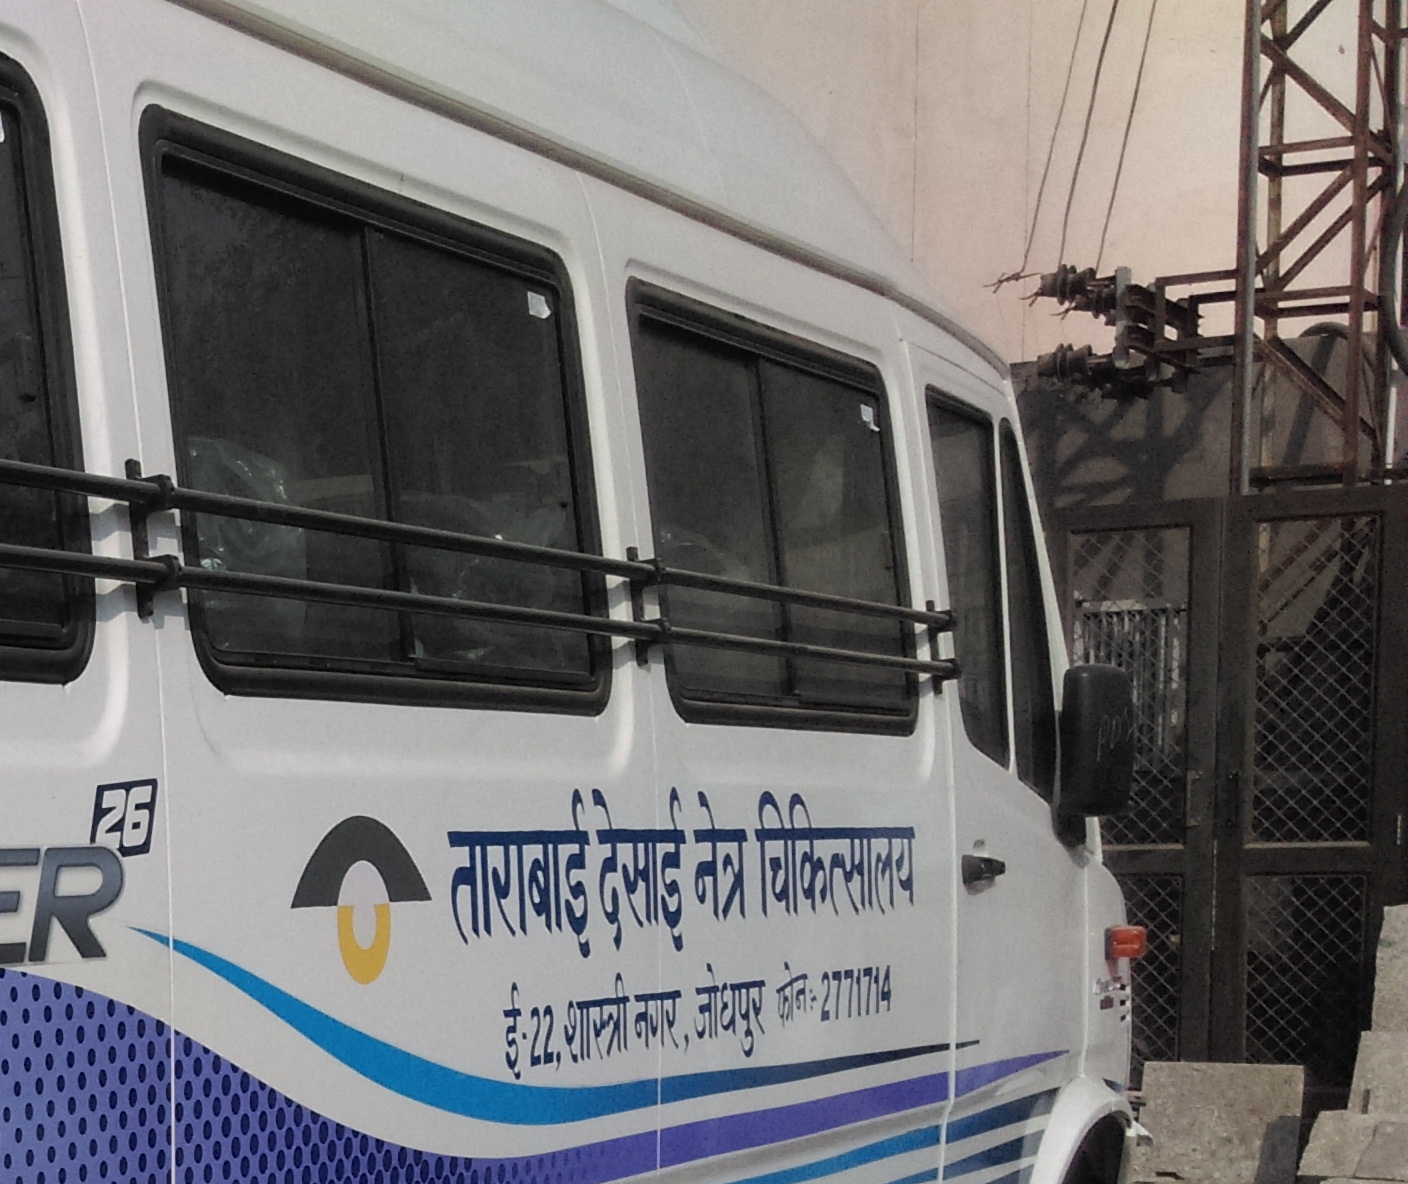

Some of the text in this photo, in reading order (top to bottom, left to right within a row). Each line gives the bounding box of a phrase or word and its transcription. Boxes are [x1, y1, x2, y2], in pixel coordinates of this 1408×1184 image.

[95, 785, 152, 847] 26
[447, 786, 916, 959] ताराबाई देसाई नेत्र चिकित्सालय
[563, 972, 631, 1064] शास्त्री
[694, 962, 767, 1058] जोधपुर
[820, 964, 892, 1022] 2771714
